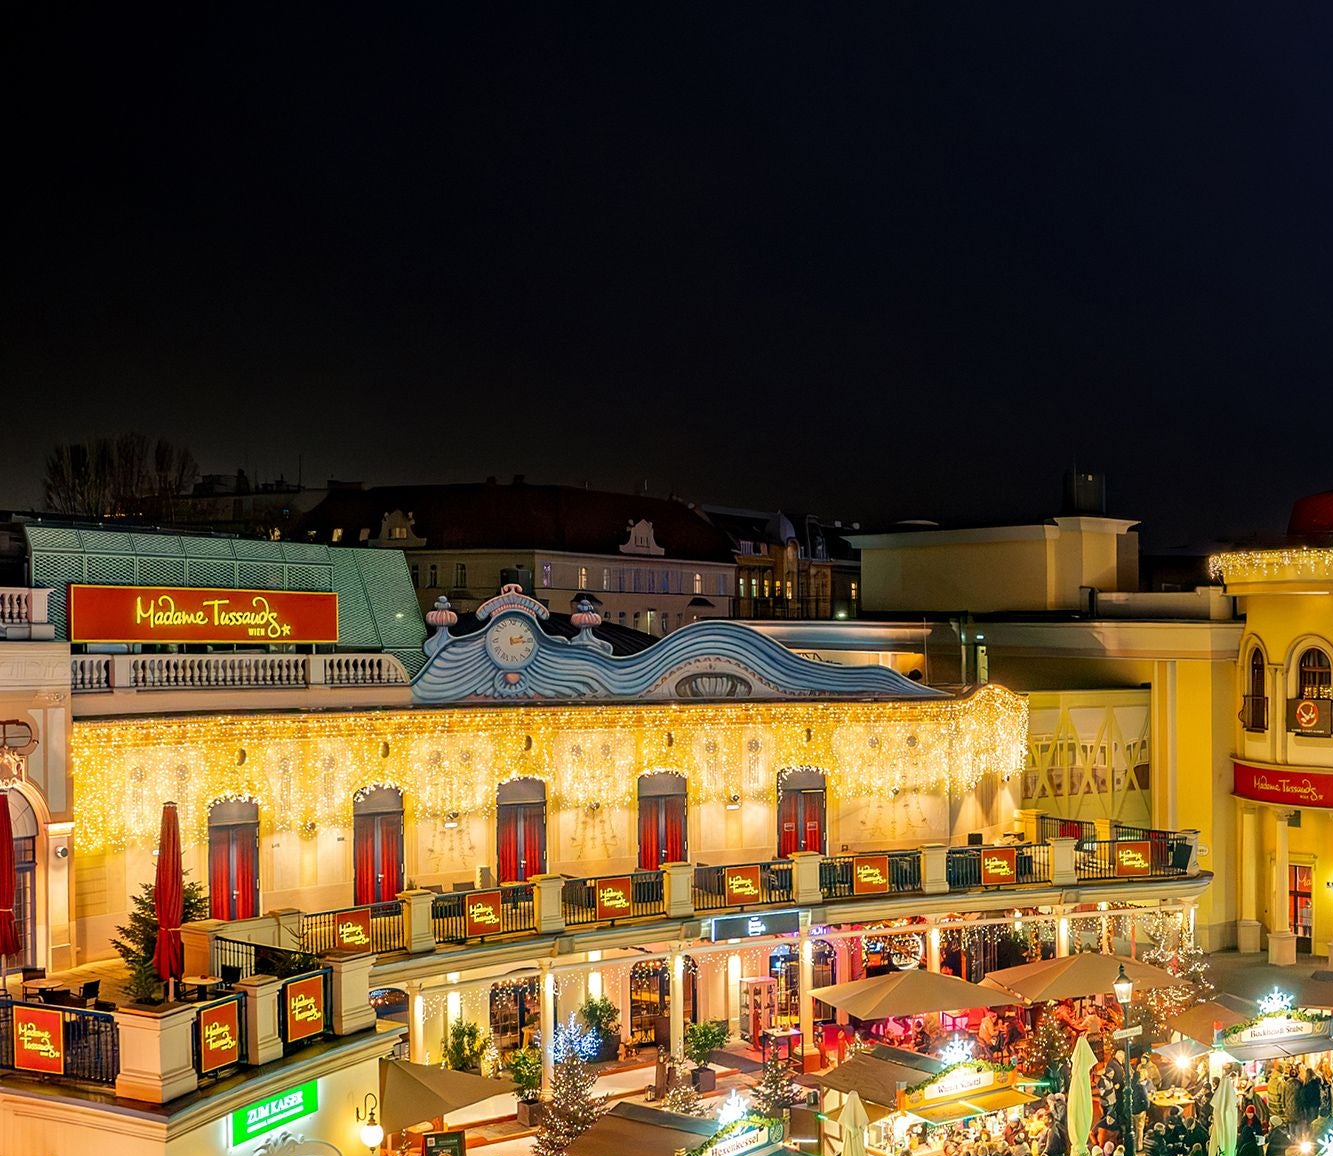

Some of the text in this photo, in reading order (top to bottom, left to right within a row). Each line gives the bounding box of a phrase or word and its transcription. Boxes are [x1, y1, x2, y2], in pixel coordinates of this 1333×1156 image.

[136, 595, 281, 638] Madame Tussauds
[248, 628, 265, 637] WIEN
[1253, 777, 1316, 801] Madame Tussauds
[18, 1022, 50, 1039] Madame
[270, 1091, 304, 1117] KAISER
